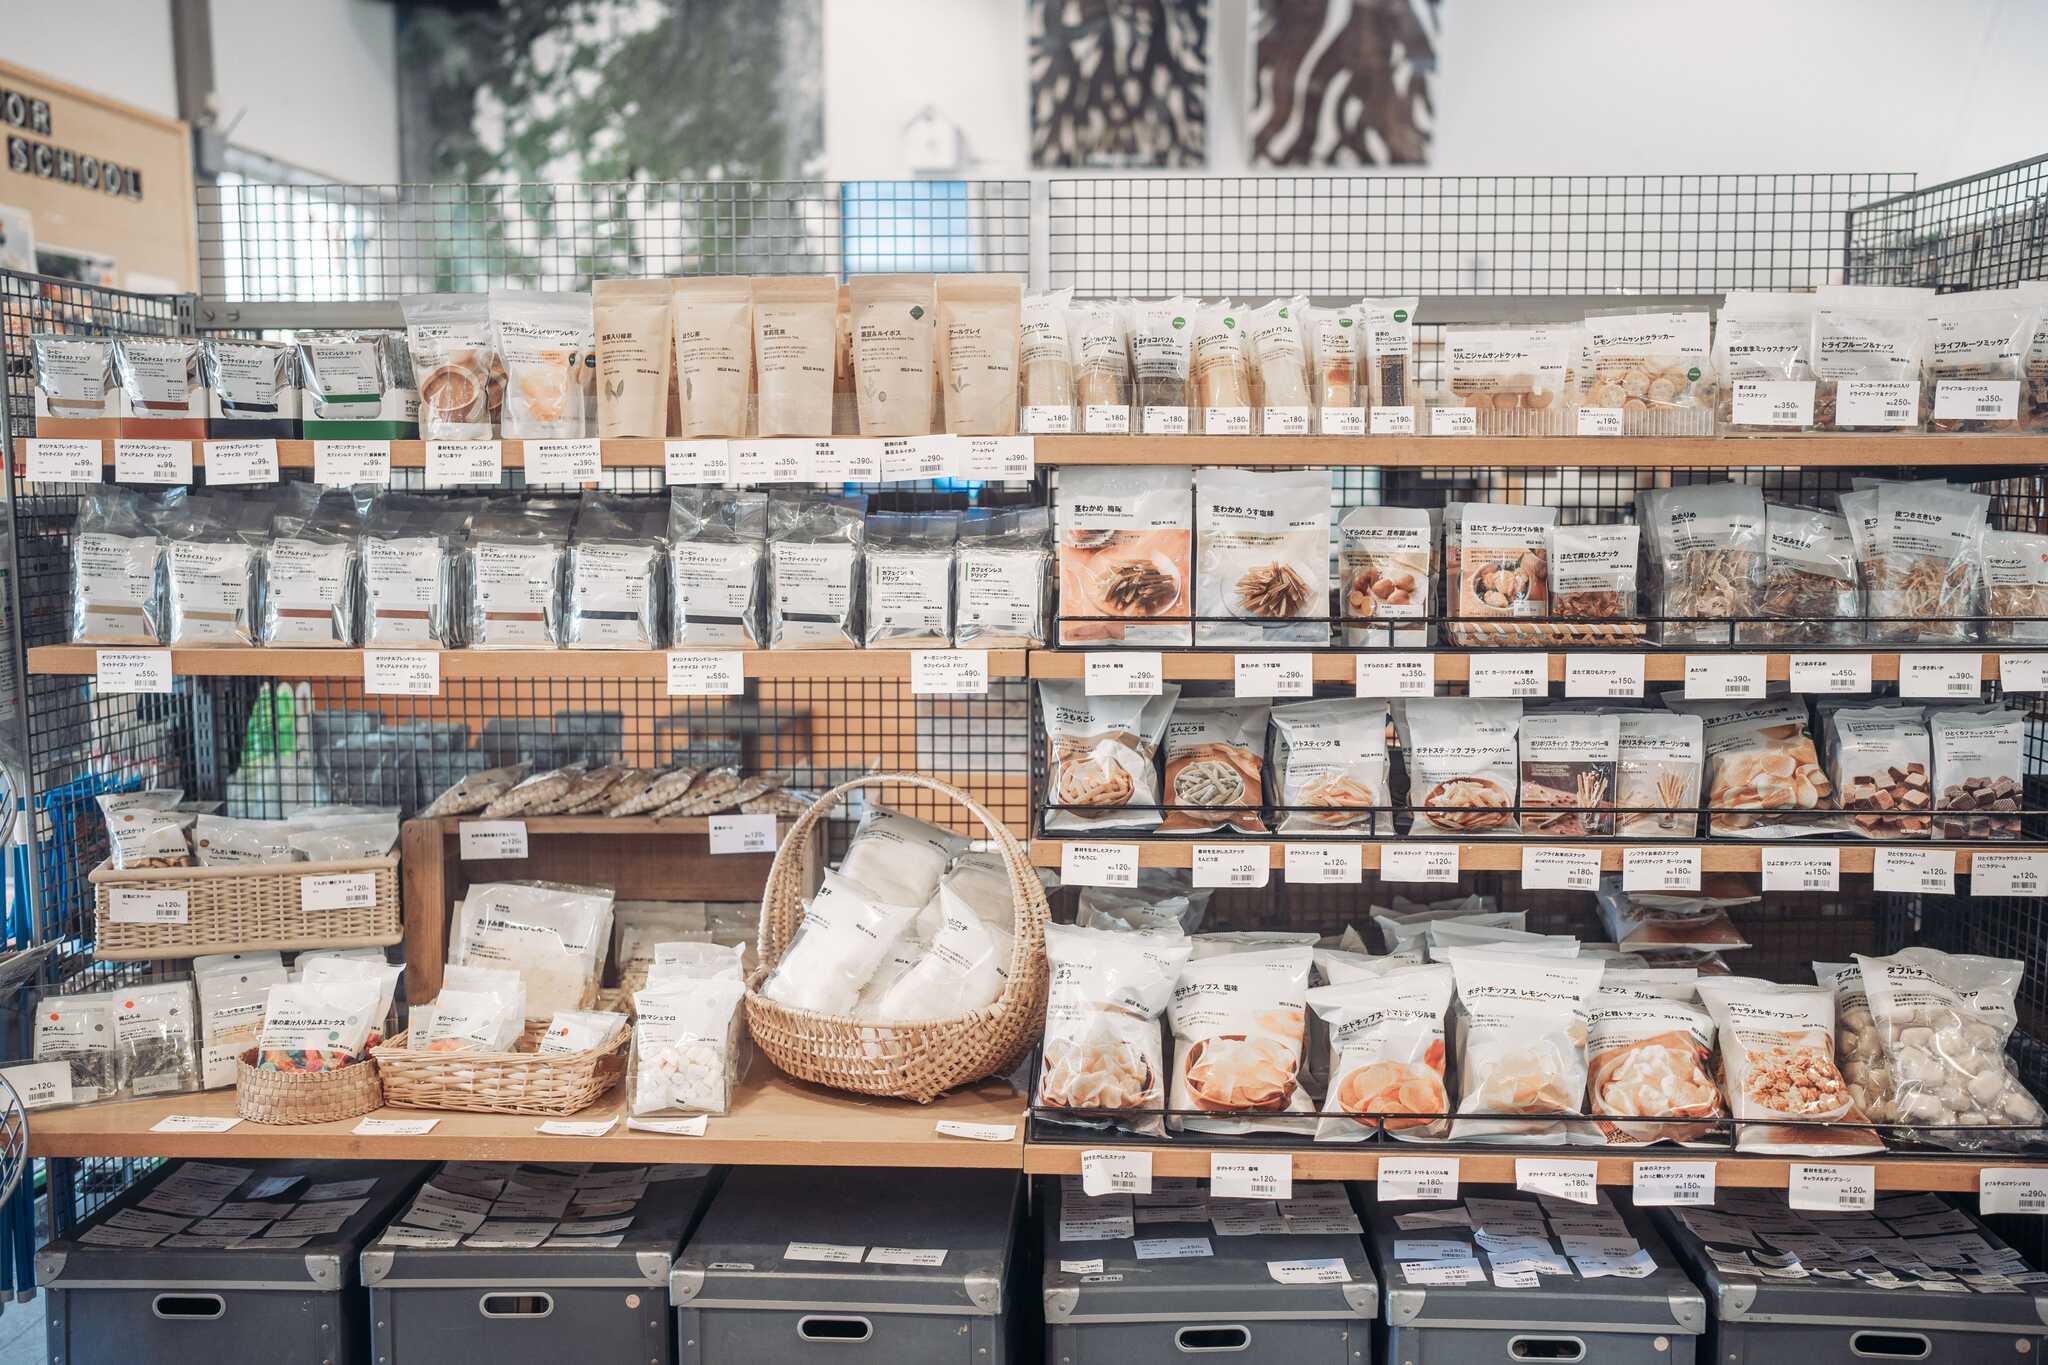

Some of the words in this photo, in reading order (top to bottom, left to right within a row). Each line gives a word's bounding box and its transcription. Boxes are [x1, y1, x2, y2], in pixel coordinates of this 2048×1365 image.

[8, 136, 143, 202] SCHOOL
[948, 327, 981, 336] アールグレイ
[1934, 338, 2010, 351] ドライフルーツミックス
[1073, 504, 1104, 513] 茎わかめ
[1212, 505, 1242, 514] 茎わかめ
[1246, 508, 1275, 517] うす塩味
[1671, 512, 1696, 521] あたりめ
[1895, 511, 1942, 522] 皮つきさきいか
[1470, 524, 1487, 532] ほたて
[1560, 550, 1619, 560] ほたて貝ひもスナック
[1169, 725, 1205, 733] えんどう豆
[1463, 746, 1511, 754] ブラックペッパー
[1174, 984, 1220, 997] ポテトチップス
[1223, 984, 1239, 992] 塩味
[1467, 987, 1517, 996] ポテトチップス
[1521, 989, 1580, 1002] レモンペッパー味
[1729, 1006, 1809, 1019] キャラメルポップコーン
